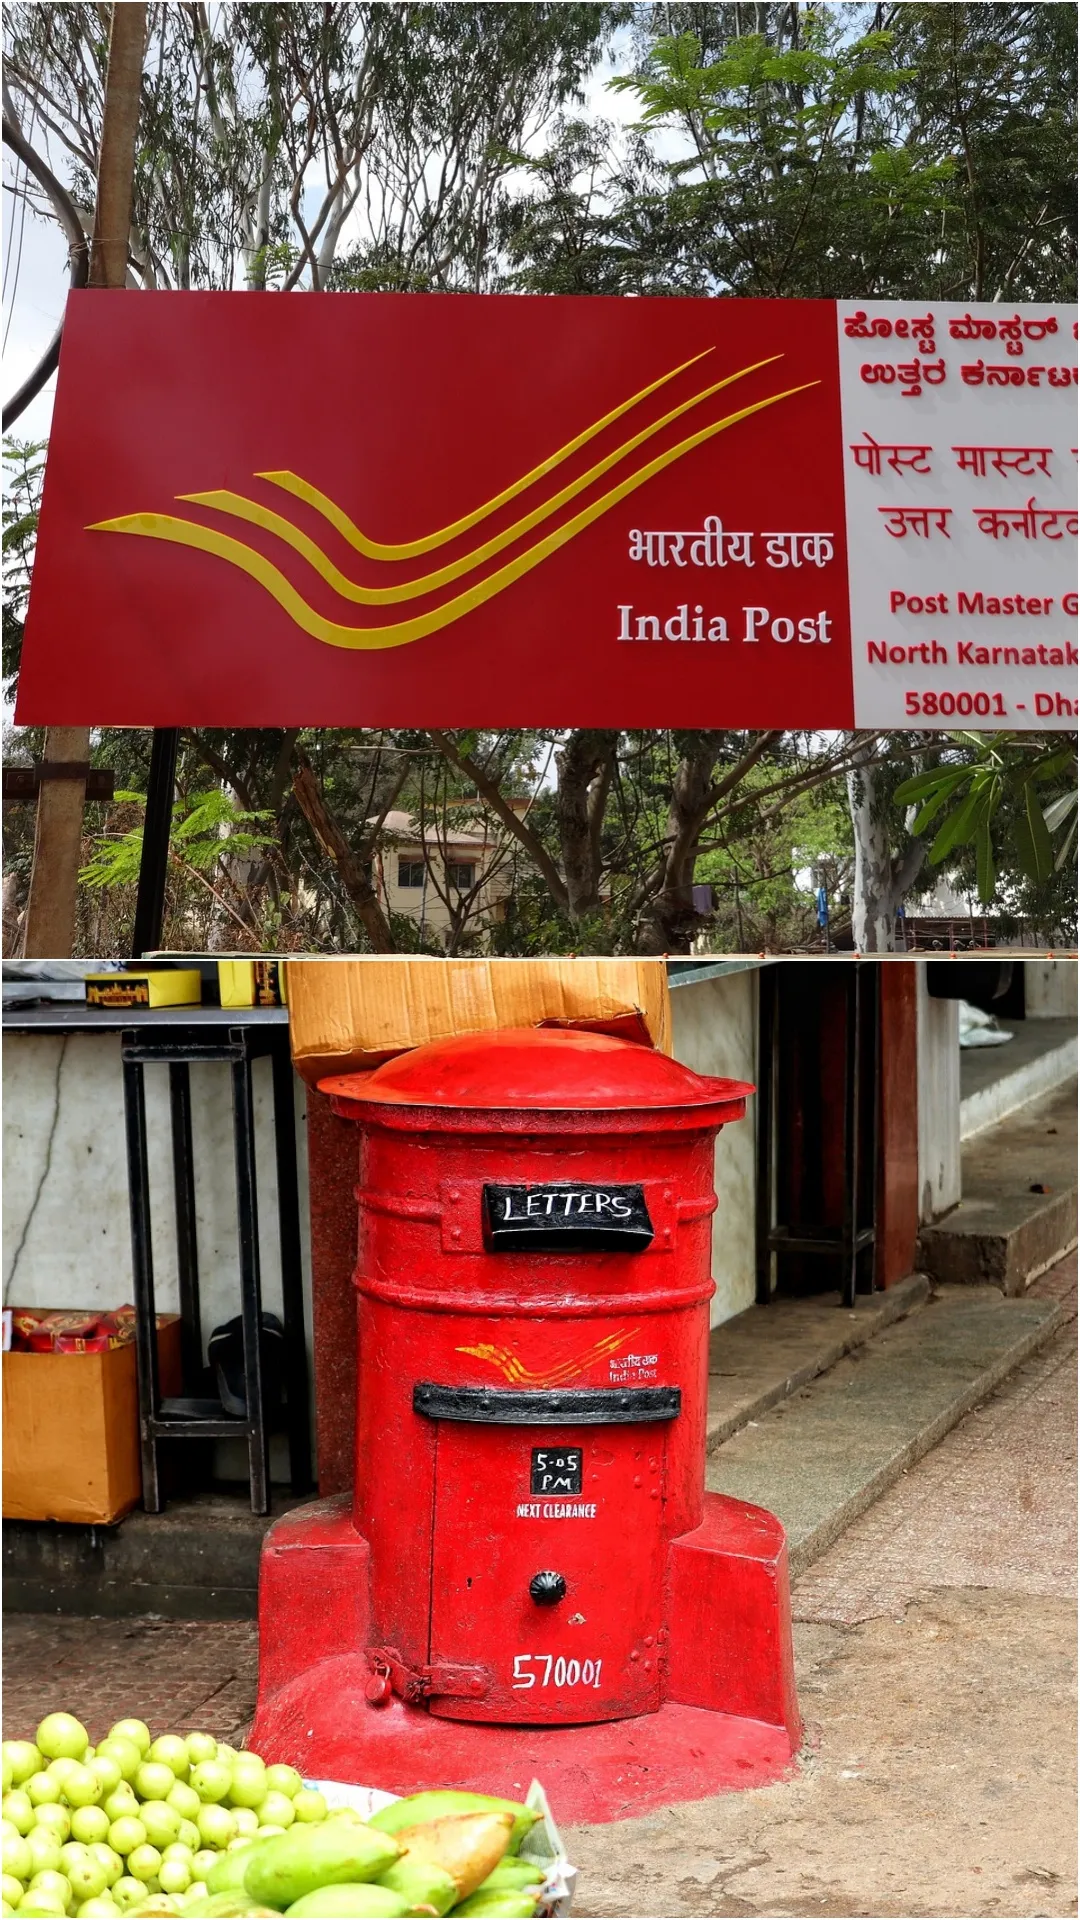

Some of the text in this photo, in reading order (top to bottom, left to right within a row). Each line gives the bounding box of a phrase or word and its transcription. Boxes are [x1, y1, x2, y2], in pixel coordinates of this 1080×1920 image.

[843, 311, 936, 354] ಪೋಸ್ಟ
[949, 313, 1059, 356] ಮಾಸ್ಟರ್
[860, 358, 1078, 396] ಉತ್ತರ ಕರ್ನಾಟ
[849, 432, 933, 475] पोस्ट
[951, 446, 1053, 478] मास्टर
[877, 506, 953, 540] उत्तर
[628, 515, 834, 568] भारतीय डाक
[890, 589, 949, 615] Post
[957, 592, 1054, 616] Master
[616, 603, 833, 644] India Post
[866, 639, 1078, 666] North Karnatak
[905, 690, 1007, 717] 580001
[1034, 691, 1078, 717] Dh
[503, 1193, 632, 1220] LETTERS
[537, 1453, 577, 1471] 5-05
[540, 1474, 572, 1490] PM
[516, 1503, 597, 1518] NEXT CLEARANCE
[512, 1654, 602, 1688] 570001
